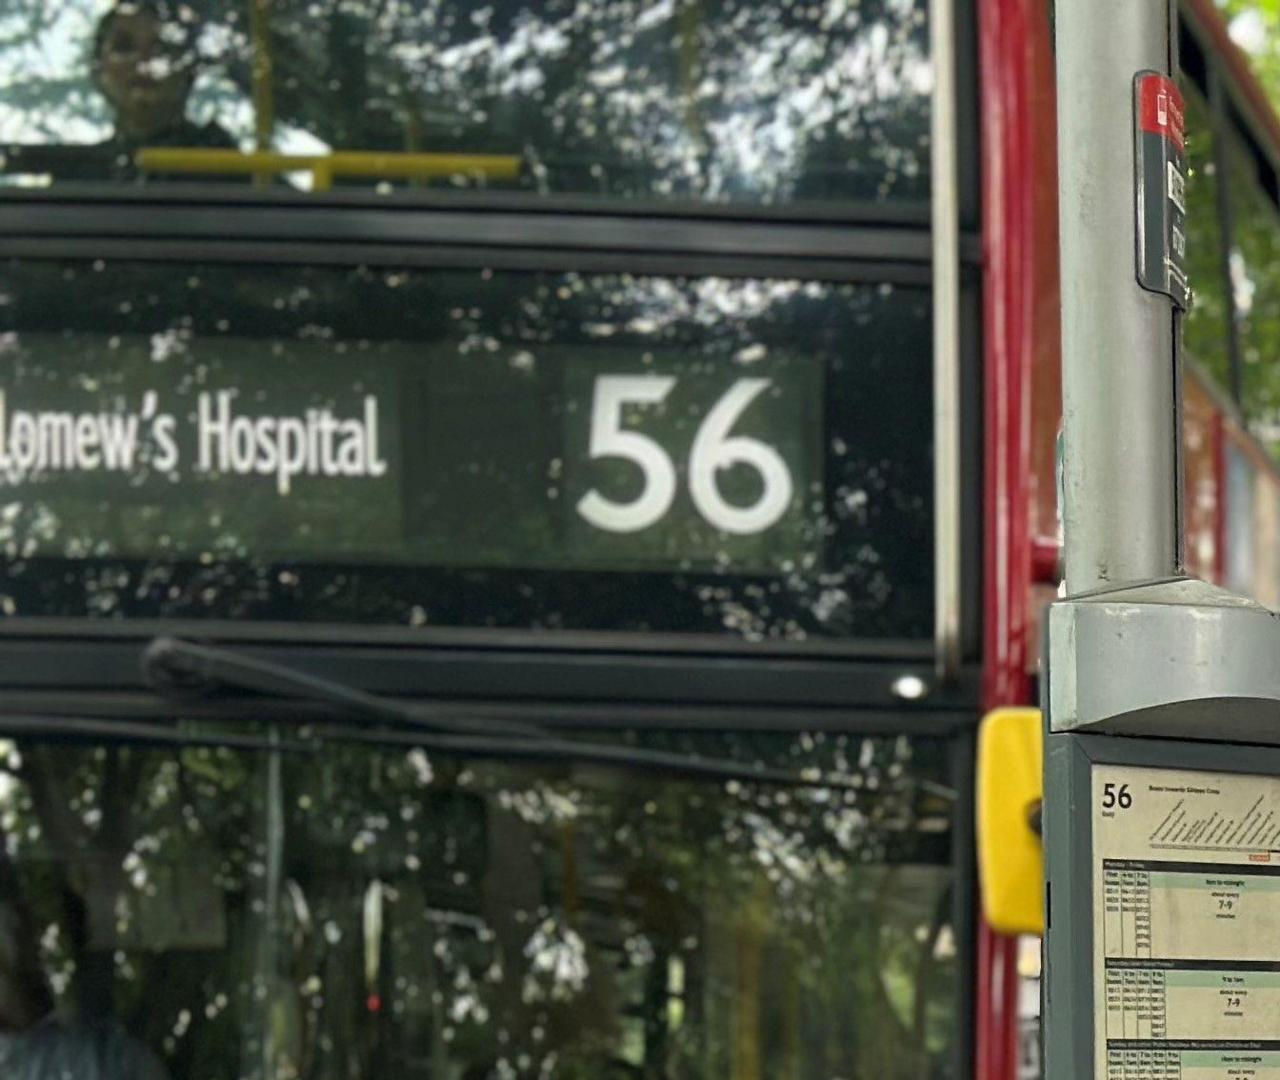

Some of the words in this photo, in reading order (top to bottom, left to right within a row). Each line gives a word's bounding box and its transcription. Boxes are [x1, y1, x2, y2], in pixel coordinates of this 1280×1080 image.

[197, 389, 388, 495] Hospital
[576, 375, 795, 534] 56
[1102, 783, 1132, 809] 56
